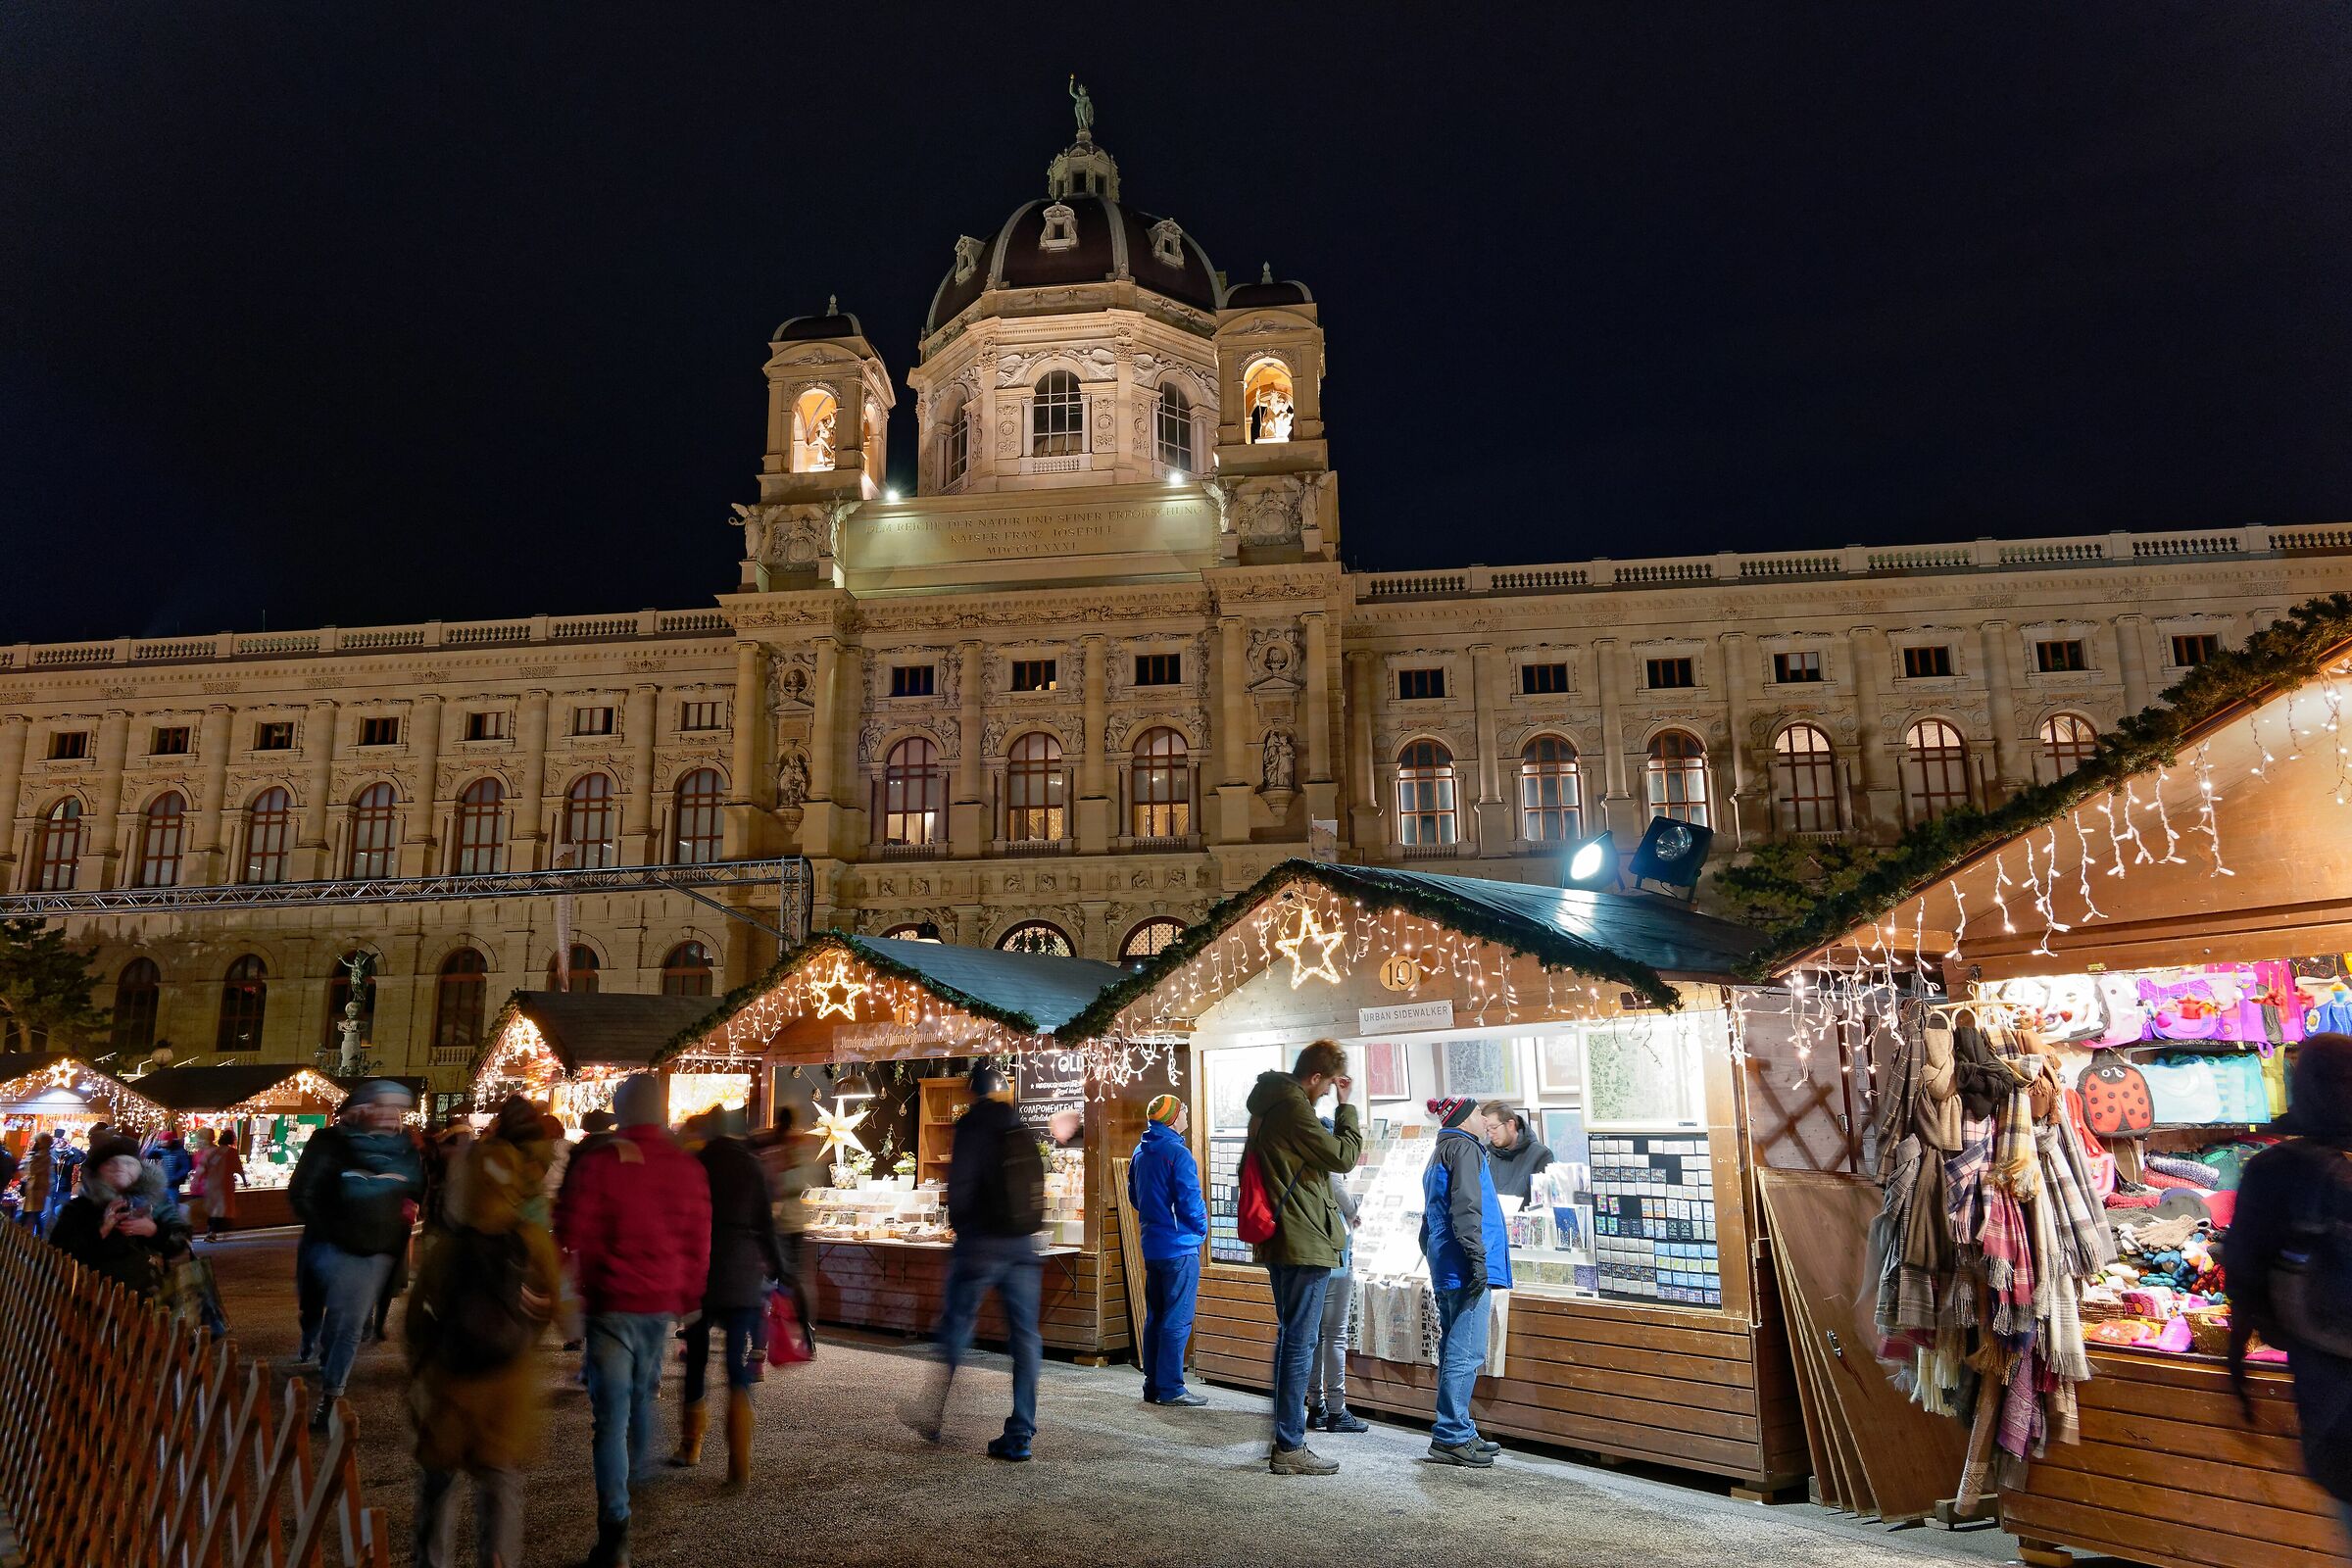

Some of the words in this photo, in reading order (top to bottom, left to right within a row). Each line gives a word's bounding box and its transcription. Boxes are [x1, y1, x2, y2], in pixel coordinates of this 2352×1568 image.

[948, 518, 973, 529] DER
[978, 516, 1021, 528] NATUR
[1026, 514, 1053, 525] UND
[1057, 511, 1102, 522] SEINER
[1108, 506, 1203, 520] ERFORSCHUNG
[951, 531, 999, 543] KAISER
[1004, 528, 1044, 540] FRANZ
[1053, 525, 1103, 538] JOSEPH
[1387, 959, 1413, 986] 10
[1363, 1011, 1392, 1022] URBAN
[1394, 1005, 1448, 1019] SIDEWALKER
[1019, 1103, 1073, 1114] KOMPONENTEN
